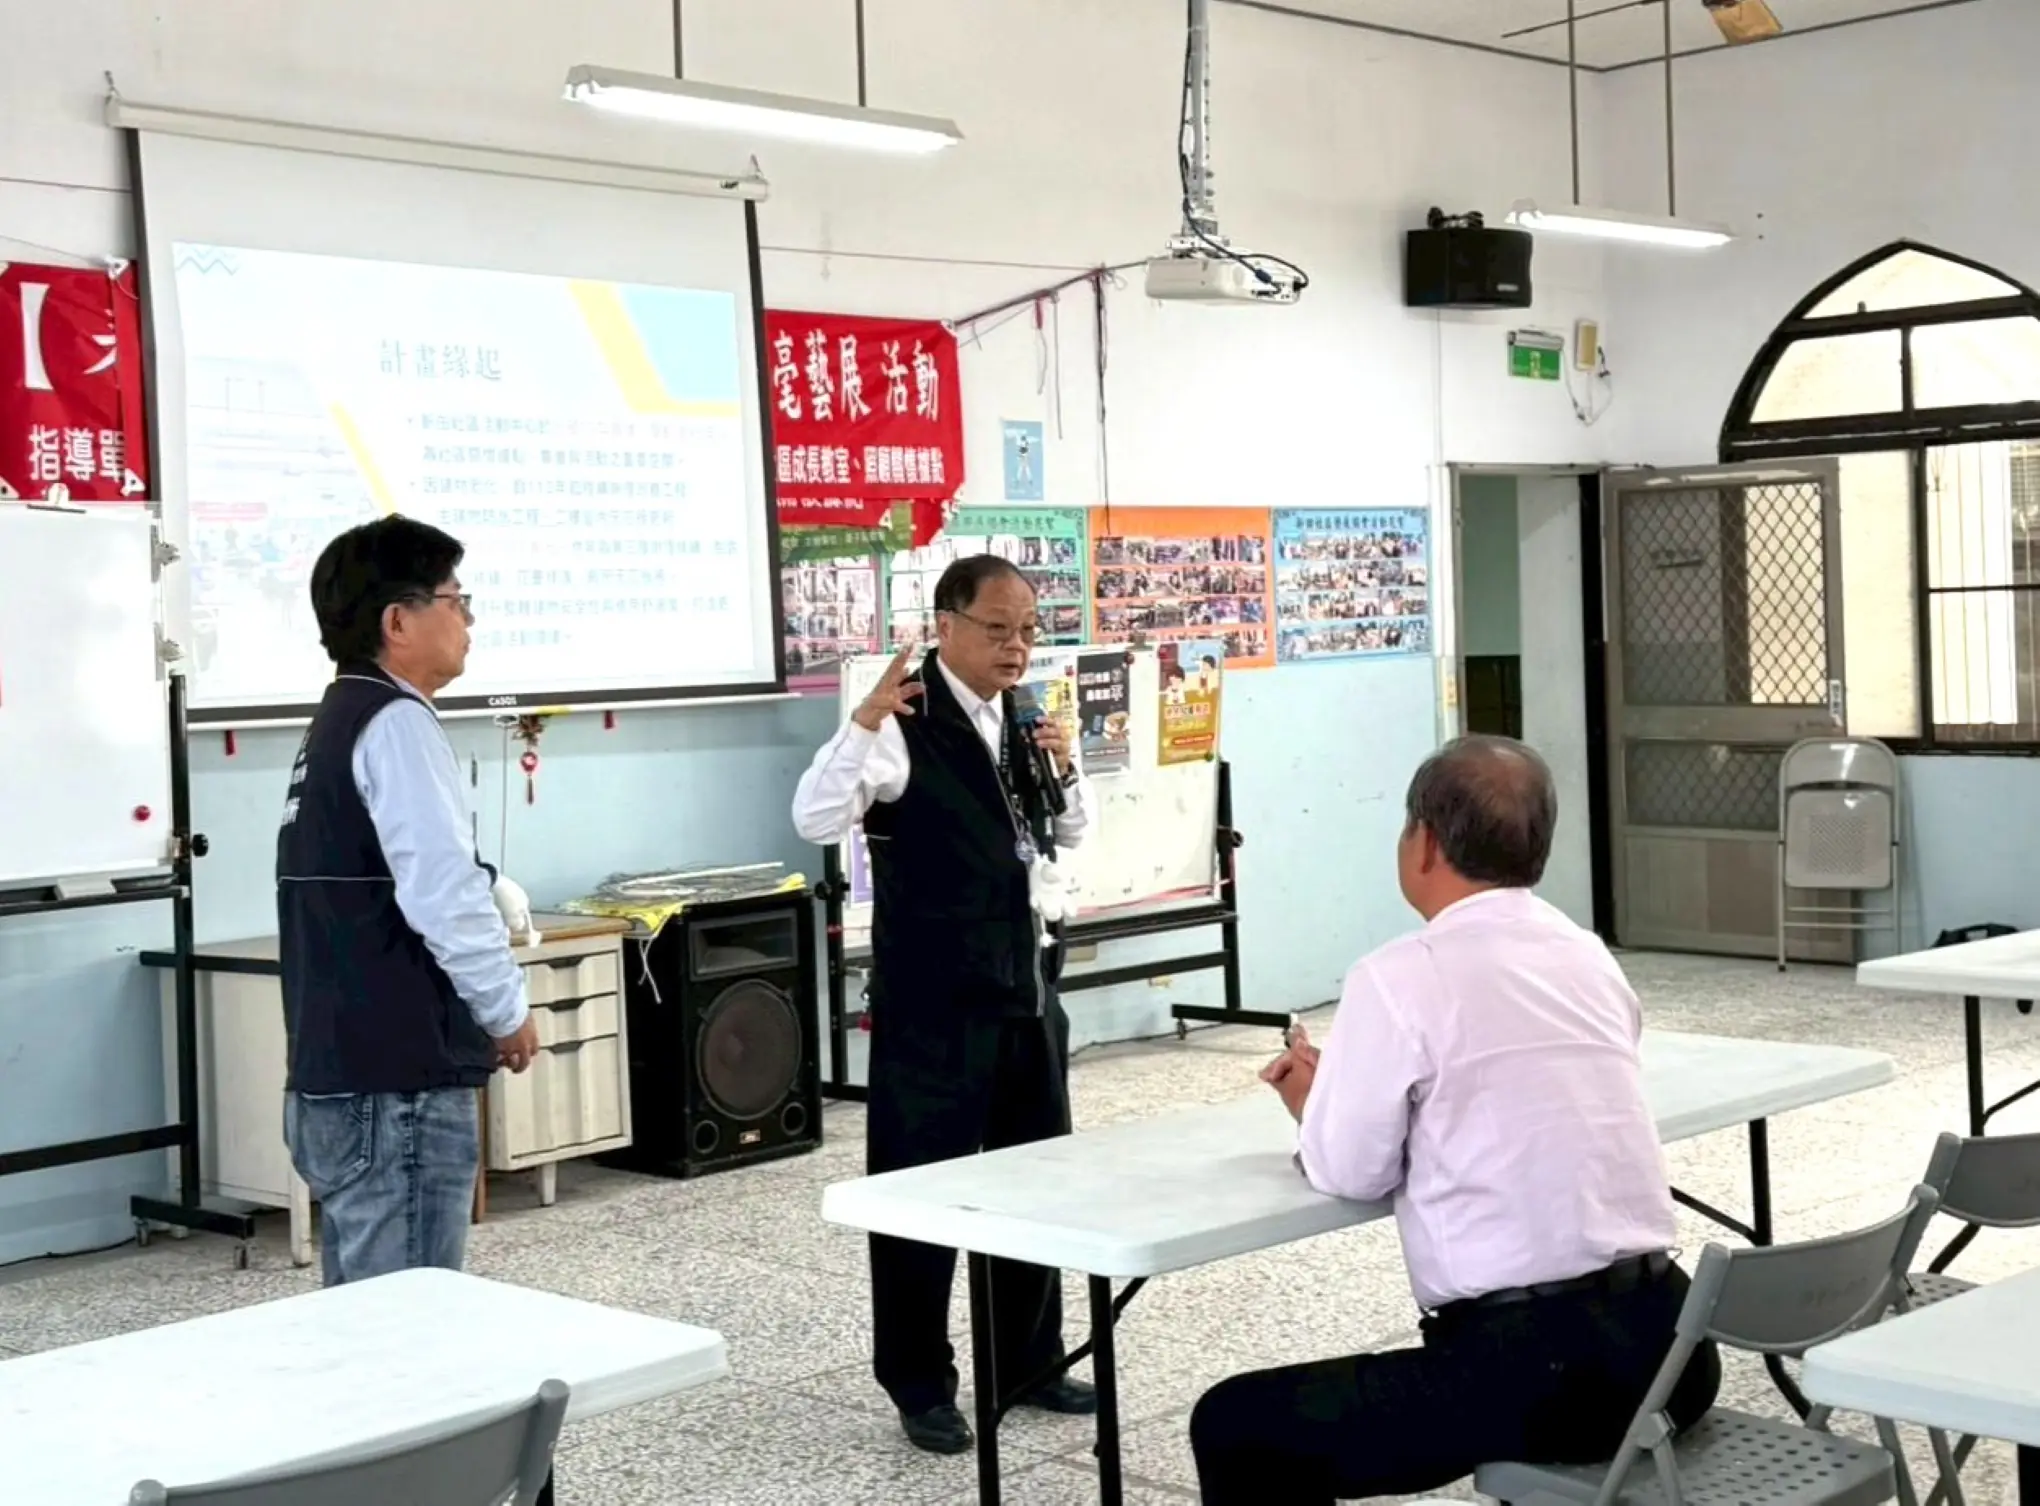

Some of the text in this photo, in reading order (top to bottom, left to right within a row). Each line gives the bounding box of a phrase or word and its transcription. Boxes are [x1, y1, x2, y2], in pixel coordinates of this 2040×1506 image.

[880, 339, 940, 424] 活動
[28, 423, 125, 483] 指導單
